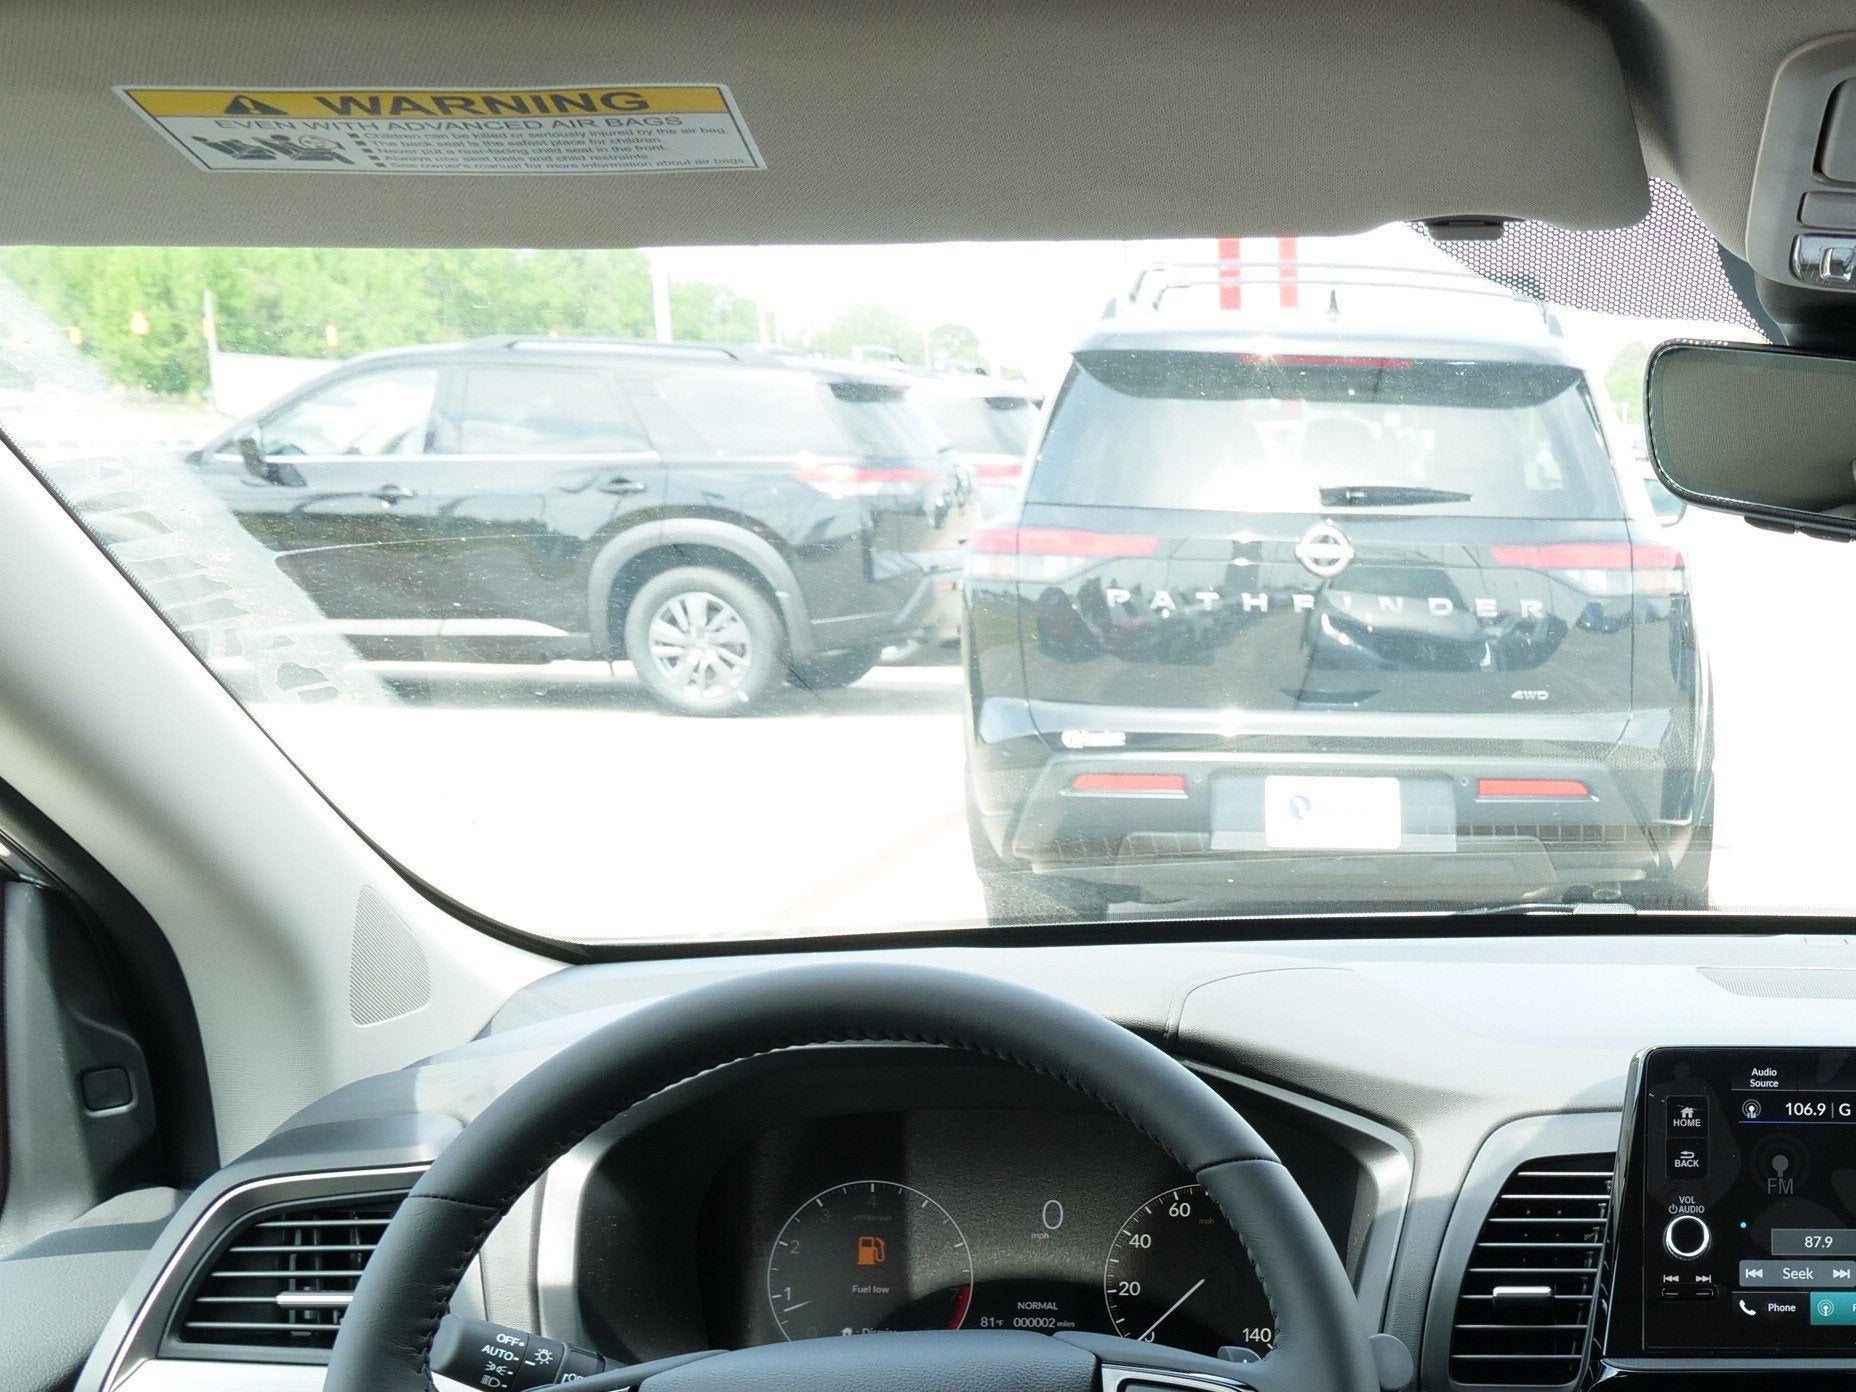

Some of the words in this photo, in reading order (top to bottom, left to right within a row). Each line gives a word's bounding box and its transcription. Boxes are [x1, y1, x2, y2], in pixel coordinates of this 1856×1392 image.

[313, 91, 649, 115] WARNING
[214, 120, 297, 130] EVEN
[302, 120, 382, 131] WITH
[387, 120, 543, 131] ADVANCED
[552, 118, 598, 129] AIR
[604, 116, 684, 128] BAGS
[1106, 589, 1543, 619] PATHFINDER
[1511, 690, 1548, 700] 4WD
[1752, 1068, 1777, 1077] Audio
[1750, 1079, 1778, 1088] Source
[1785, 1103, 1826, 1116] 106.9
[1839, 1103, 1851, 1116] G
[1673, 1119, 1700, 1127] HOME
[1675, 1160, 1699, 1168] BACK
[1768, 1178, 1793, 1194] FM
[1042, 1200, 1063, 1229] 0
[1169, 1203, 1190, 1217] 60
[791, 1240, 800, 1254] 2
[1129, 1234, 1151, 1248] 40
[1805, 1236, 1833, 1248] 87.9
[1783, 1268, 1814, 1279] Seek
[784, 1287, 791, 1300] 1
[852, 1285, 870, 1293] Fuel
[873, 1285, 890, 1293] low
[1119, 1282, 1140, 1296] 20
[1018, 1302, 1058, 1310] NORMAL
[1768, 1303, 1796, 1312] Phone
[1013, 1318, 1055, 1327] 000002
[497, 1334, 520, 1346] OFF
[1242, 1328, 1272, 1342] 140
[482, 1345, 514, 1361] AUTO
